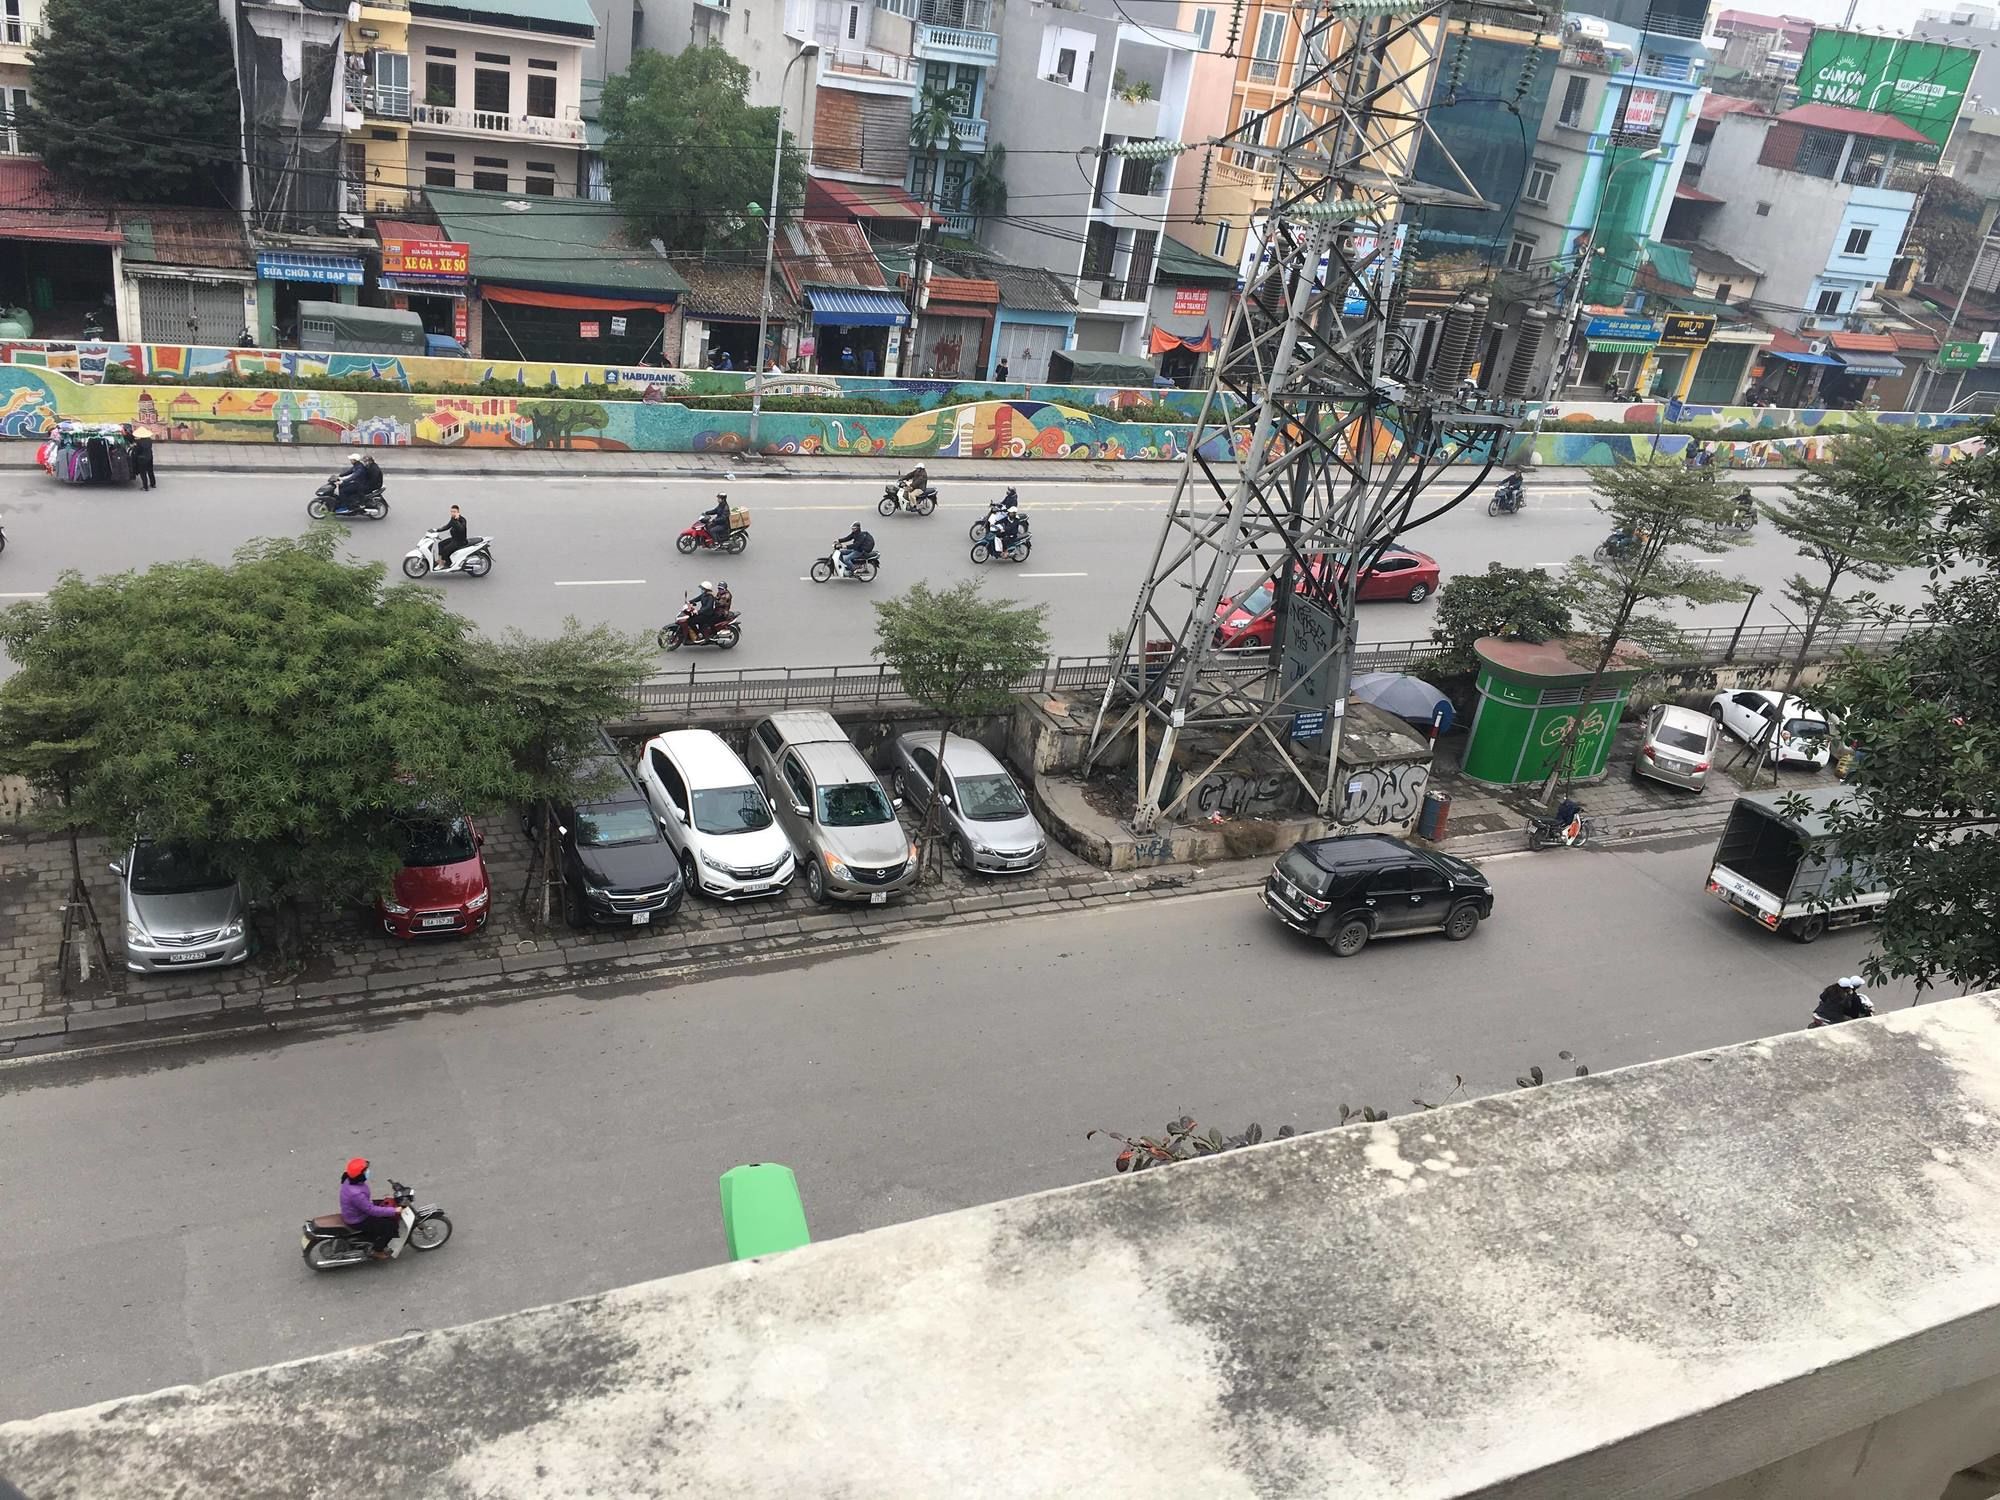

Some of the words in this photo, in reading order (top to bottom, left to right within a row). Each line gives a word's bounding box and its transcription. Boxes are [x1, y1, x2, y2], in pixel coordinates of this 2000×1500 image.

[1812, 83, 1824, 98] 5
[404, 256, 418, 270] XE
[419, 257, 433, 270] GA
[439, 258, 453, 271] XE
[453, 253, 466, 272] SỐ
[263, 265, 283, 276] SỬA
[312, 270, 324, 279] XE
[622, 372, 676, 382] HABUBANK
